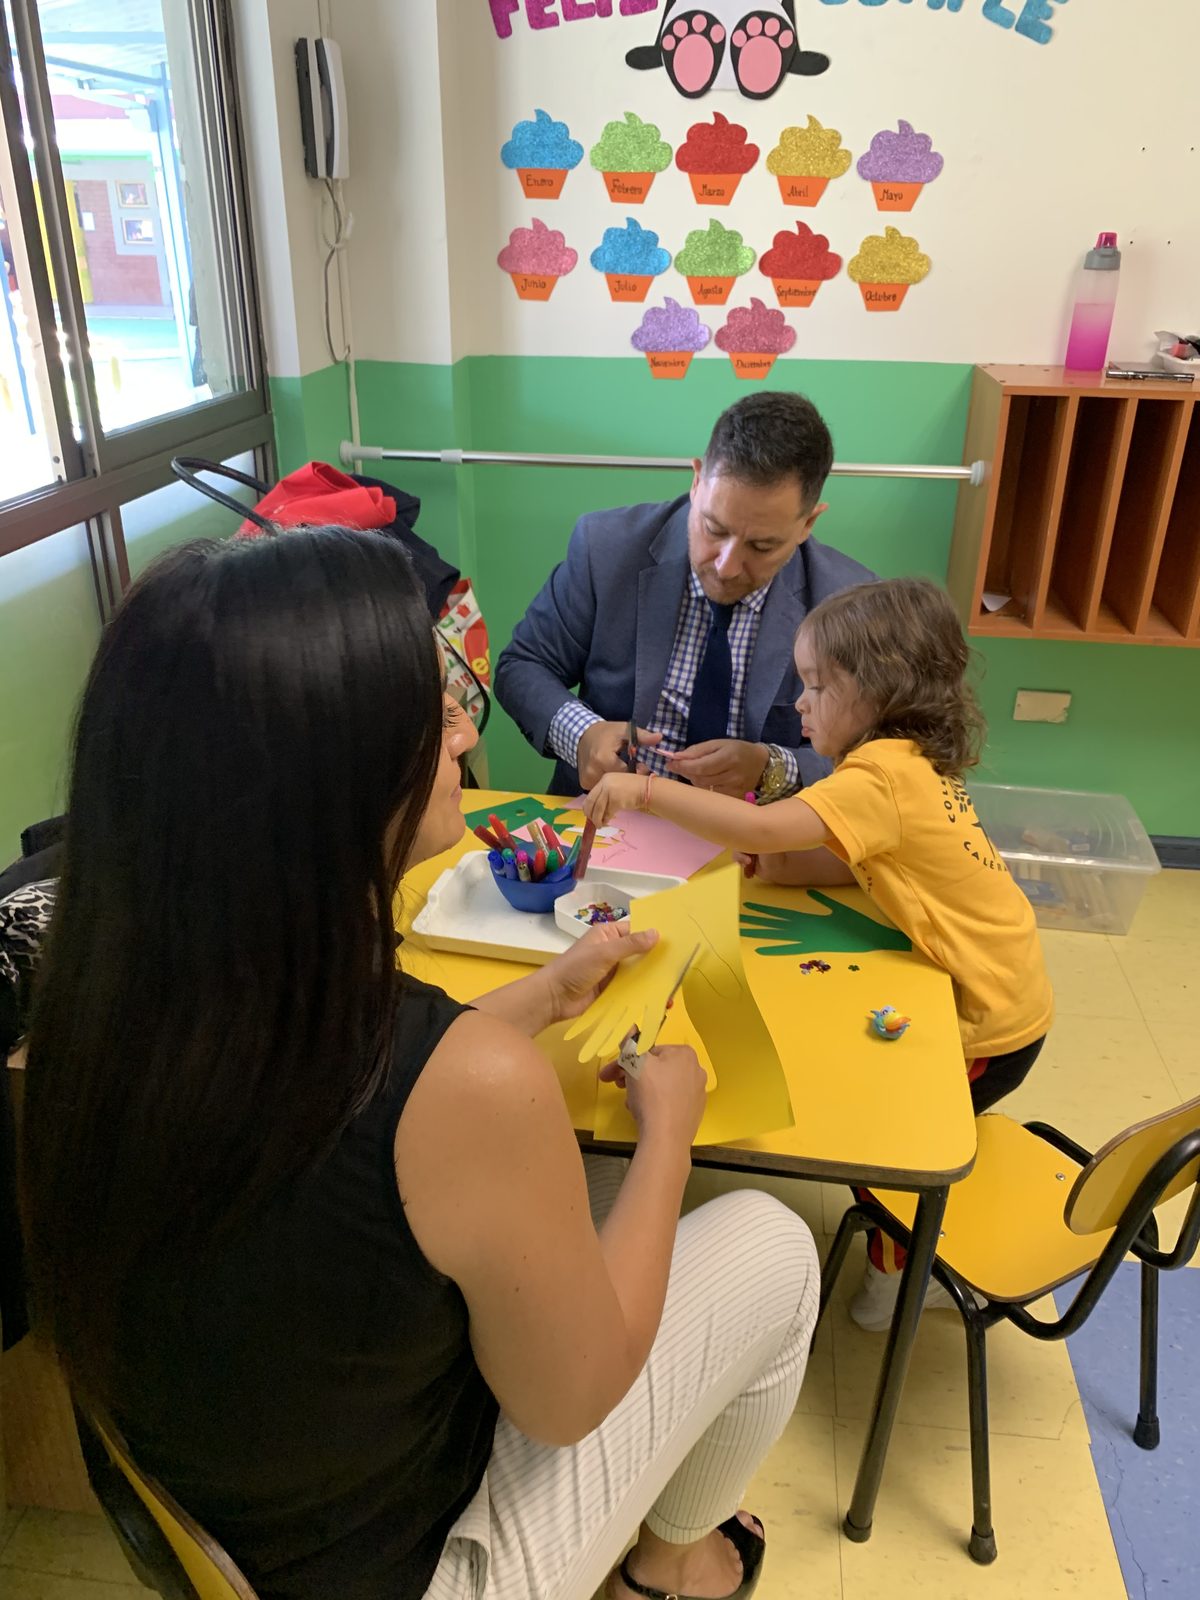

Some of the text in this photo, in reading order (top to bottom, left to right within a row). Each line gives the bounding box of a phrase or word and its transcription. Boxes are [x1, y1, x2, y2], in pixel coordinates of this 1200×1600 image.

[525, 174, 554, 187] Enero
[611, 178, 643, 195] Febrero
[698, 184, 725, 197] Marzo
[787, 185, 809, 198] Abril
[879, 188, 904, 202] Mayo
[521, 278, 546, 291] Junio
[614, 280, 638, 293] Julio
[697, 283, 723, 299] Agosto
[865, 290, 897, 302] Octubre
